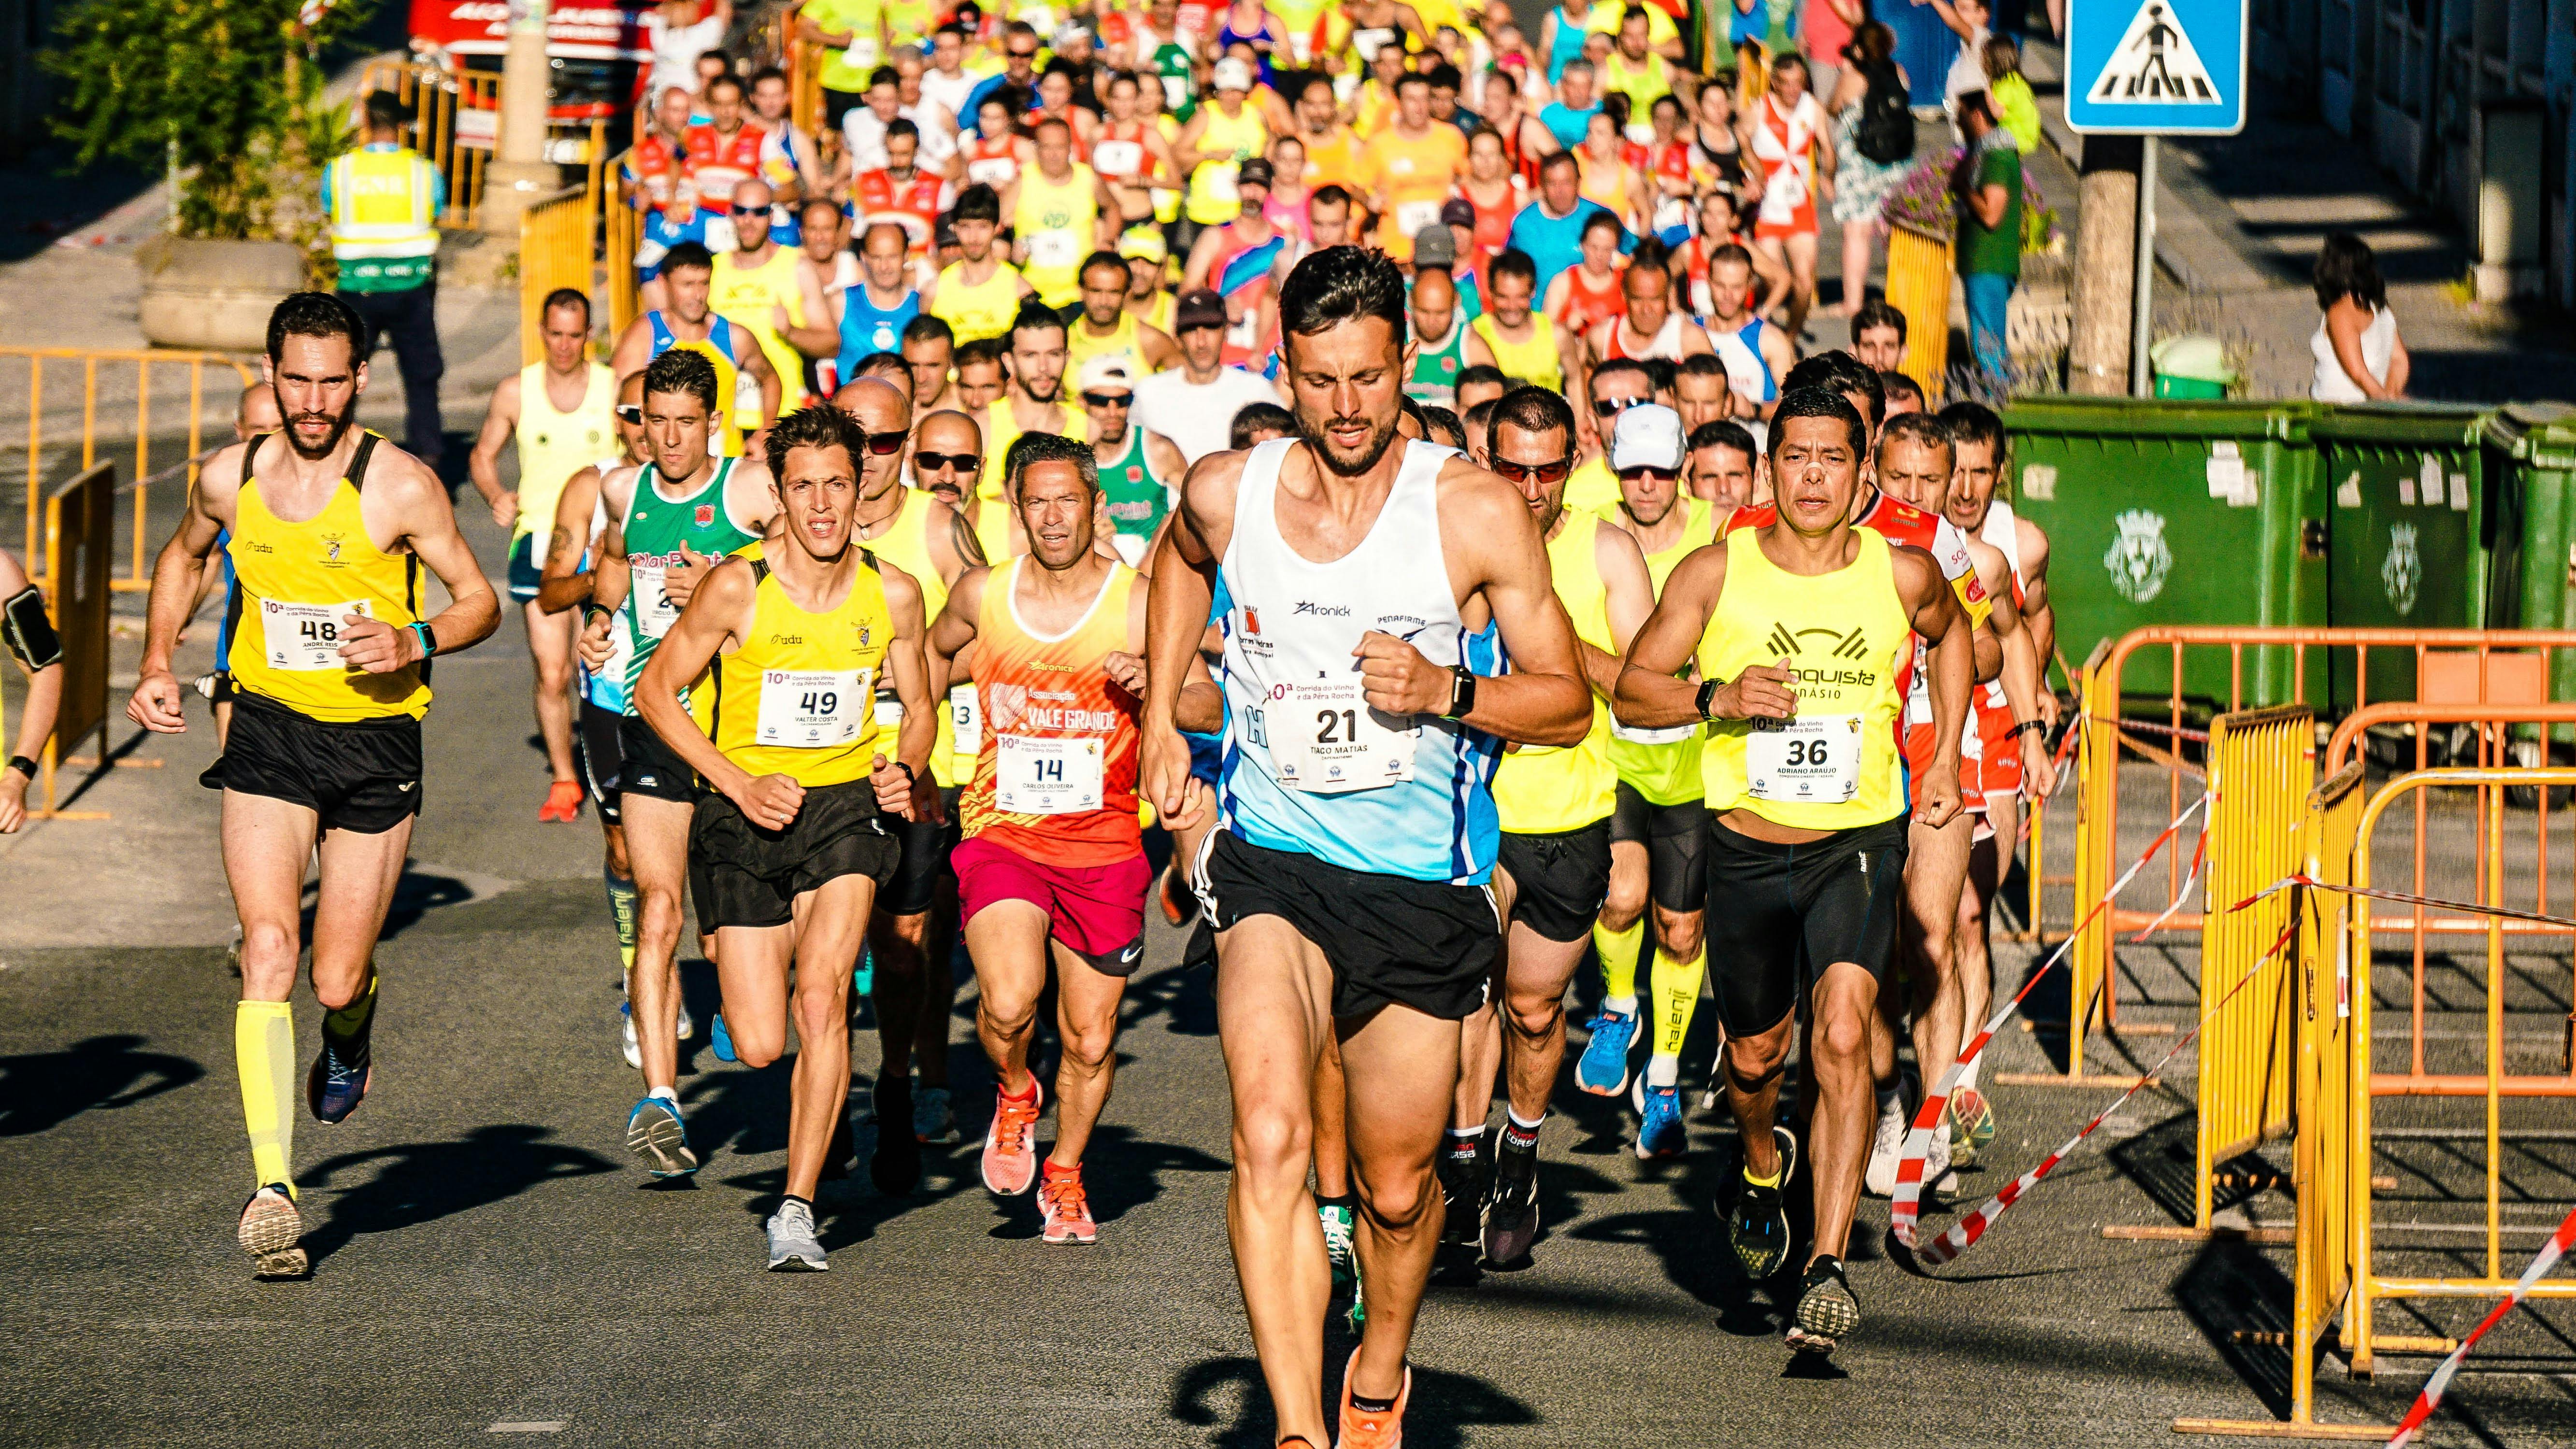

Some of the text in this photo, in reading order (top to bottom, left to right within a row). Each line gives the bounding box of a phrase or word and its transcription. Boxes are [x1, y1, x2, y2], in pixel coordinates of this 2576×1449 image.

[1295, 600, 1351, 617] Aronick
[300, 621, 337, 641] 48
[1030, 661, 1075, 673] Aronick
[800, 692, 837, 715] 49
[1028, 688, 1075, 703] Associação
[1789, 688, 1841, 699] INÁSIO
[1028, 707, 1116, 731] VALE GRANDE
[1317, 710, 1356, 743] 21
[1311, 745, 1368, 754] TIAGO MATIAS
[1787, 739, 1827, 766] 36
[1034, 759, 1063, 781] 14
